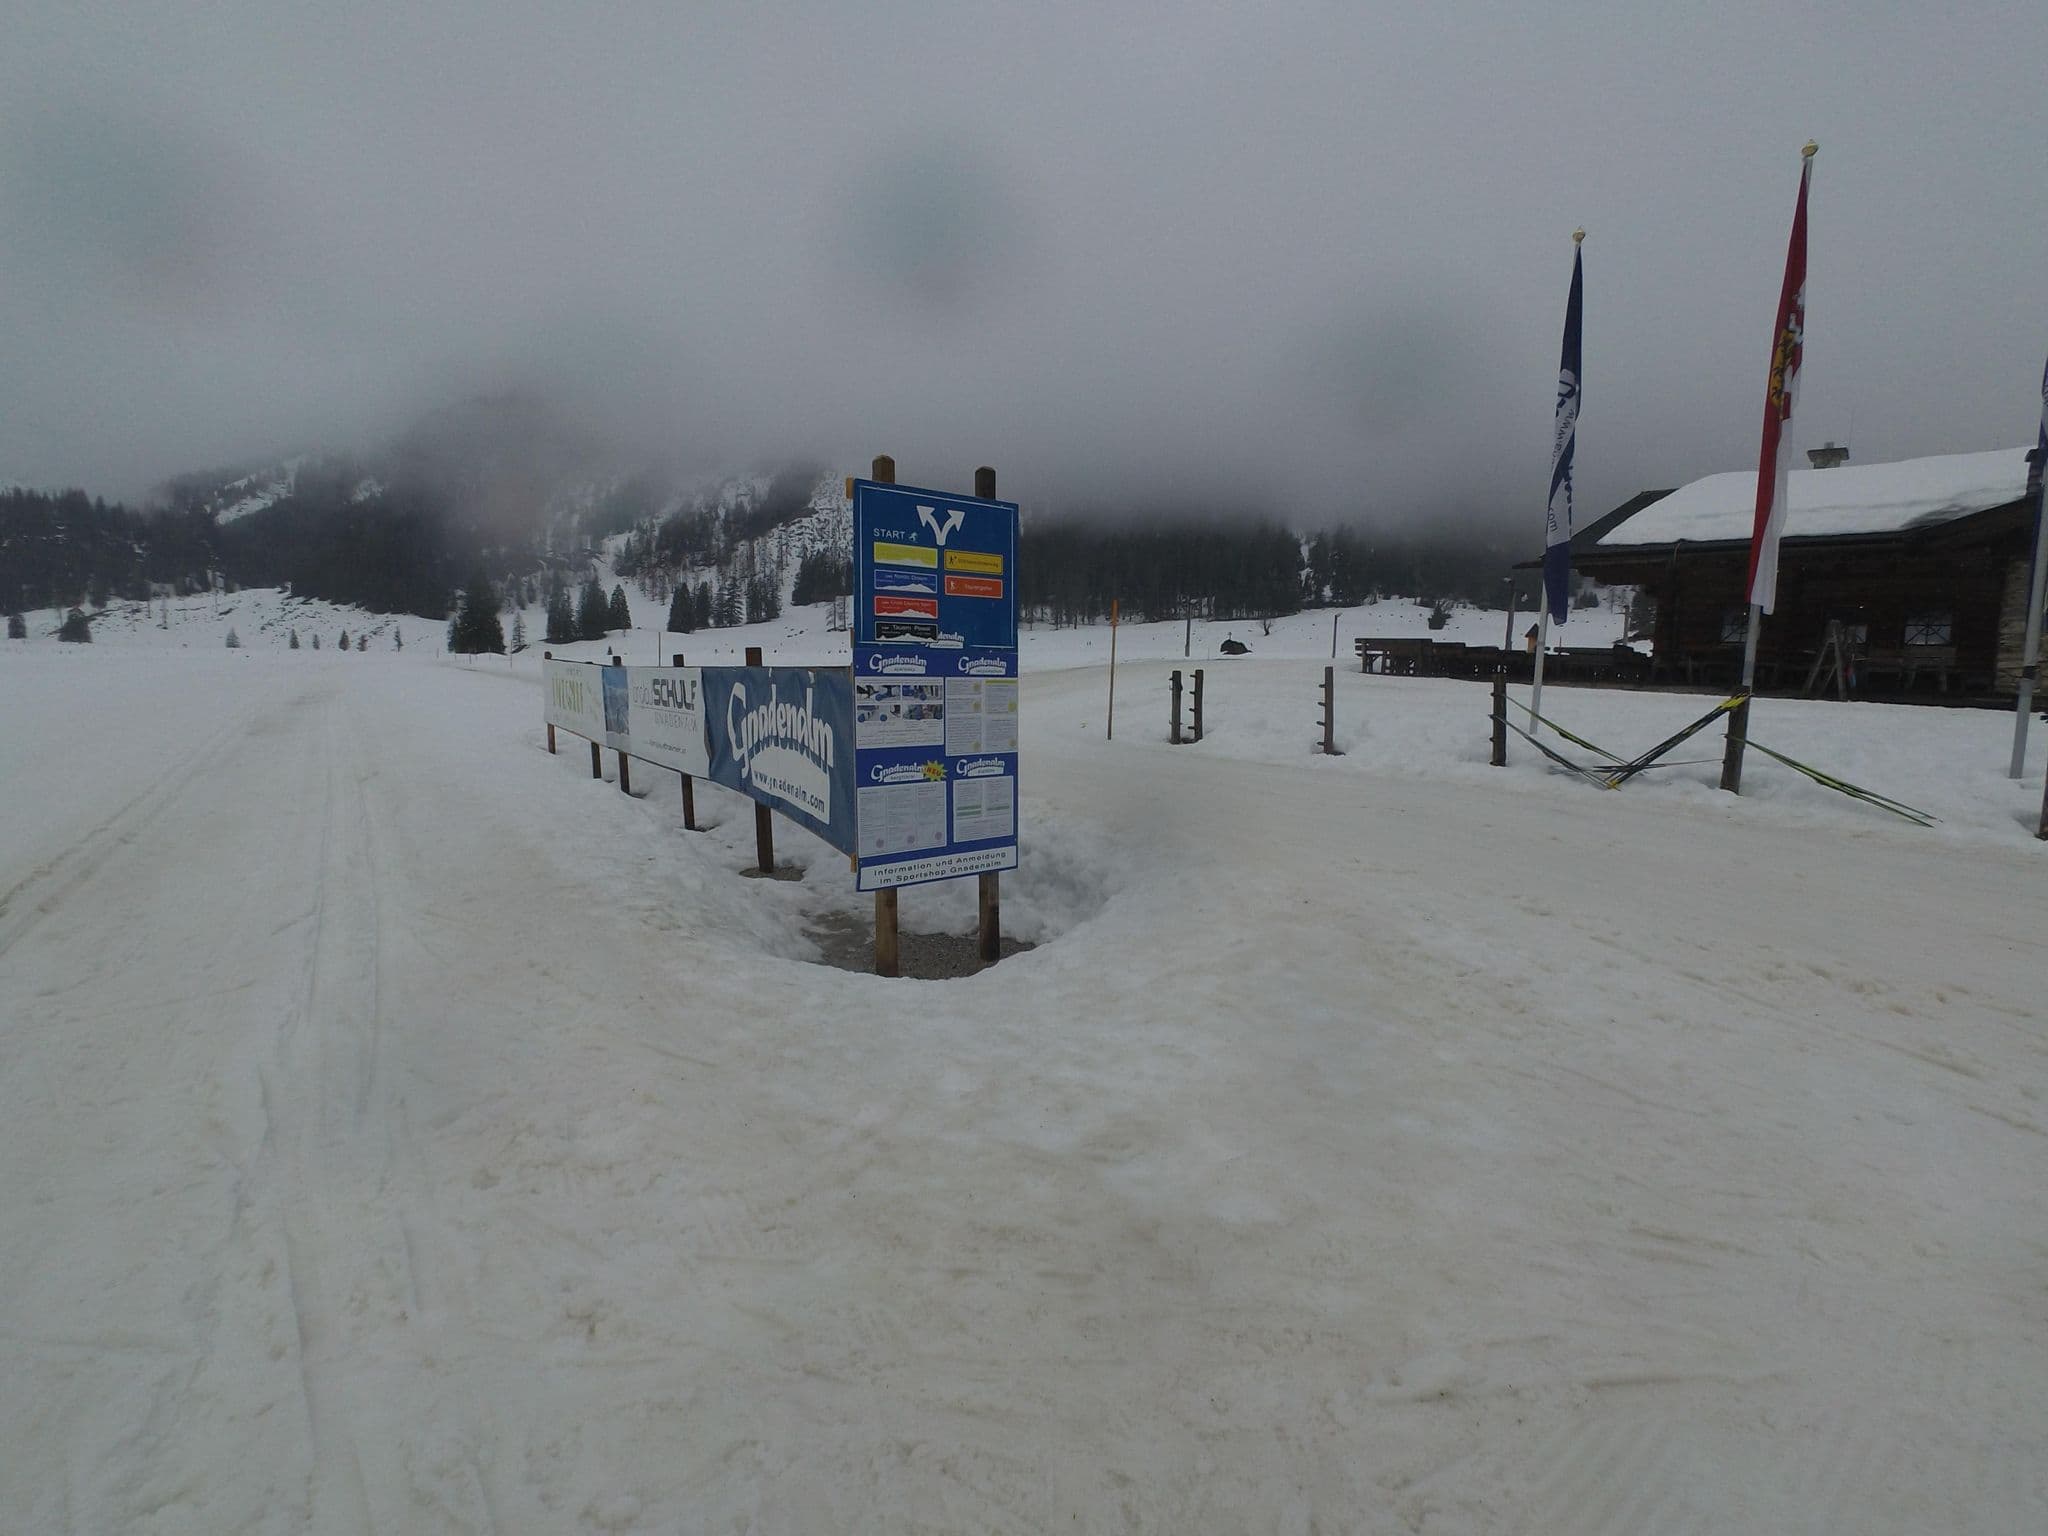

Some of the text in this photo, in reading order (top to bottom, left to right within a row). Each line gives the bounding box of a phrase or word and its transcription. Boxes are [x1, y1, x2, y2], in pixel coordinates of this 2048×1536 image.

[873, 528, 905, 540] START
[869, 653, 927, 673] Gnadenalm
[958, 656, 1007, 674] Gnadenalm
[727, 682, 834, 779] Gnadenalm
[870, 762, 924, 782] Gnadenalm
[956, 757, 1006, 776] Gnadenalm
[754, 770, 825, 814] www.gnadenalm.com
[874, 851, 1007, 876] Information und Anmeldung
[896, 868, 947, 882] Sportshop
[950, 861, 1002, 874] Gnadenalm
